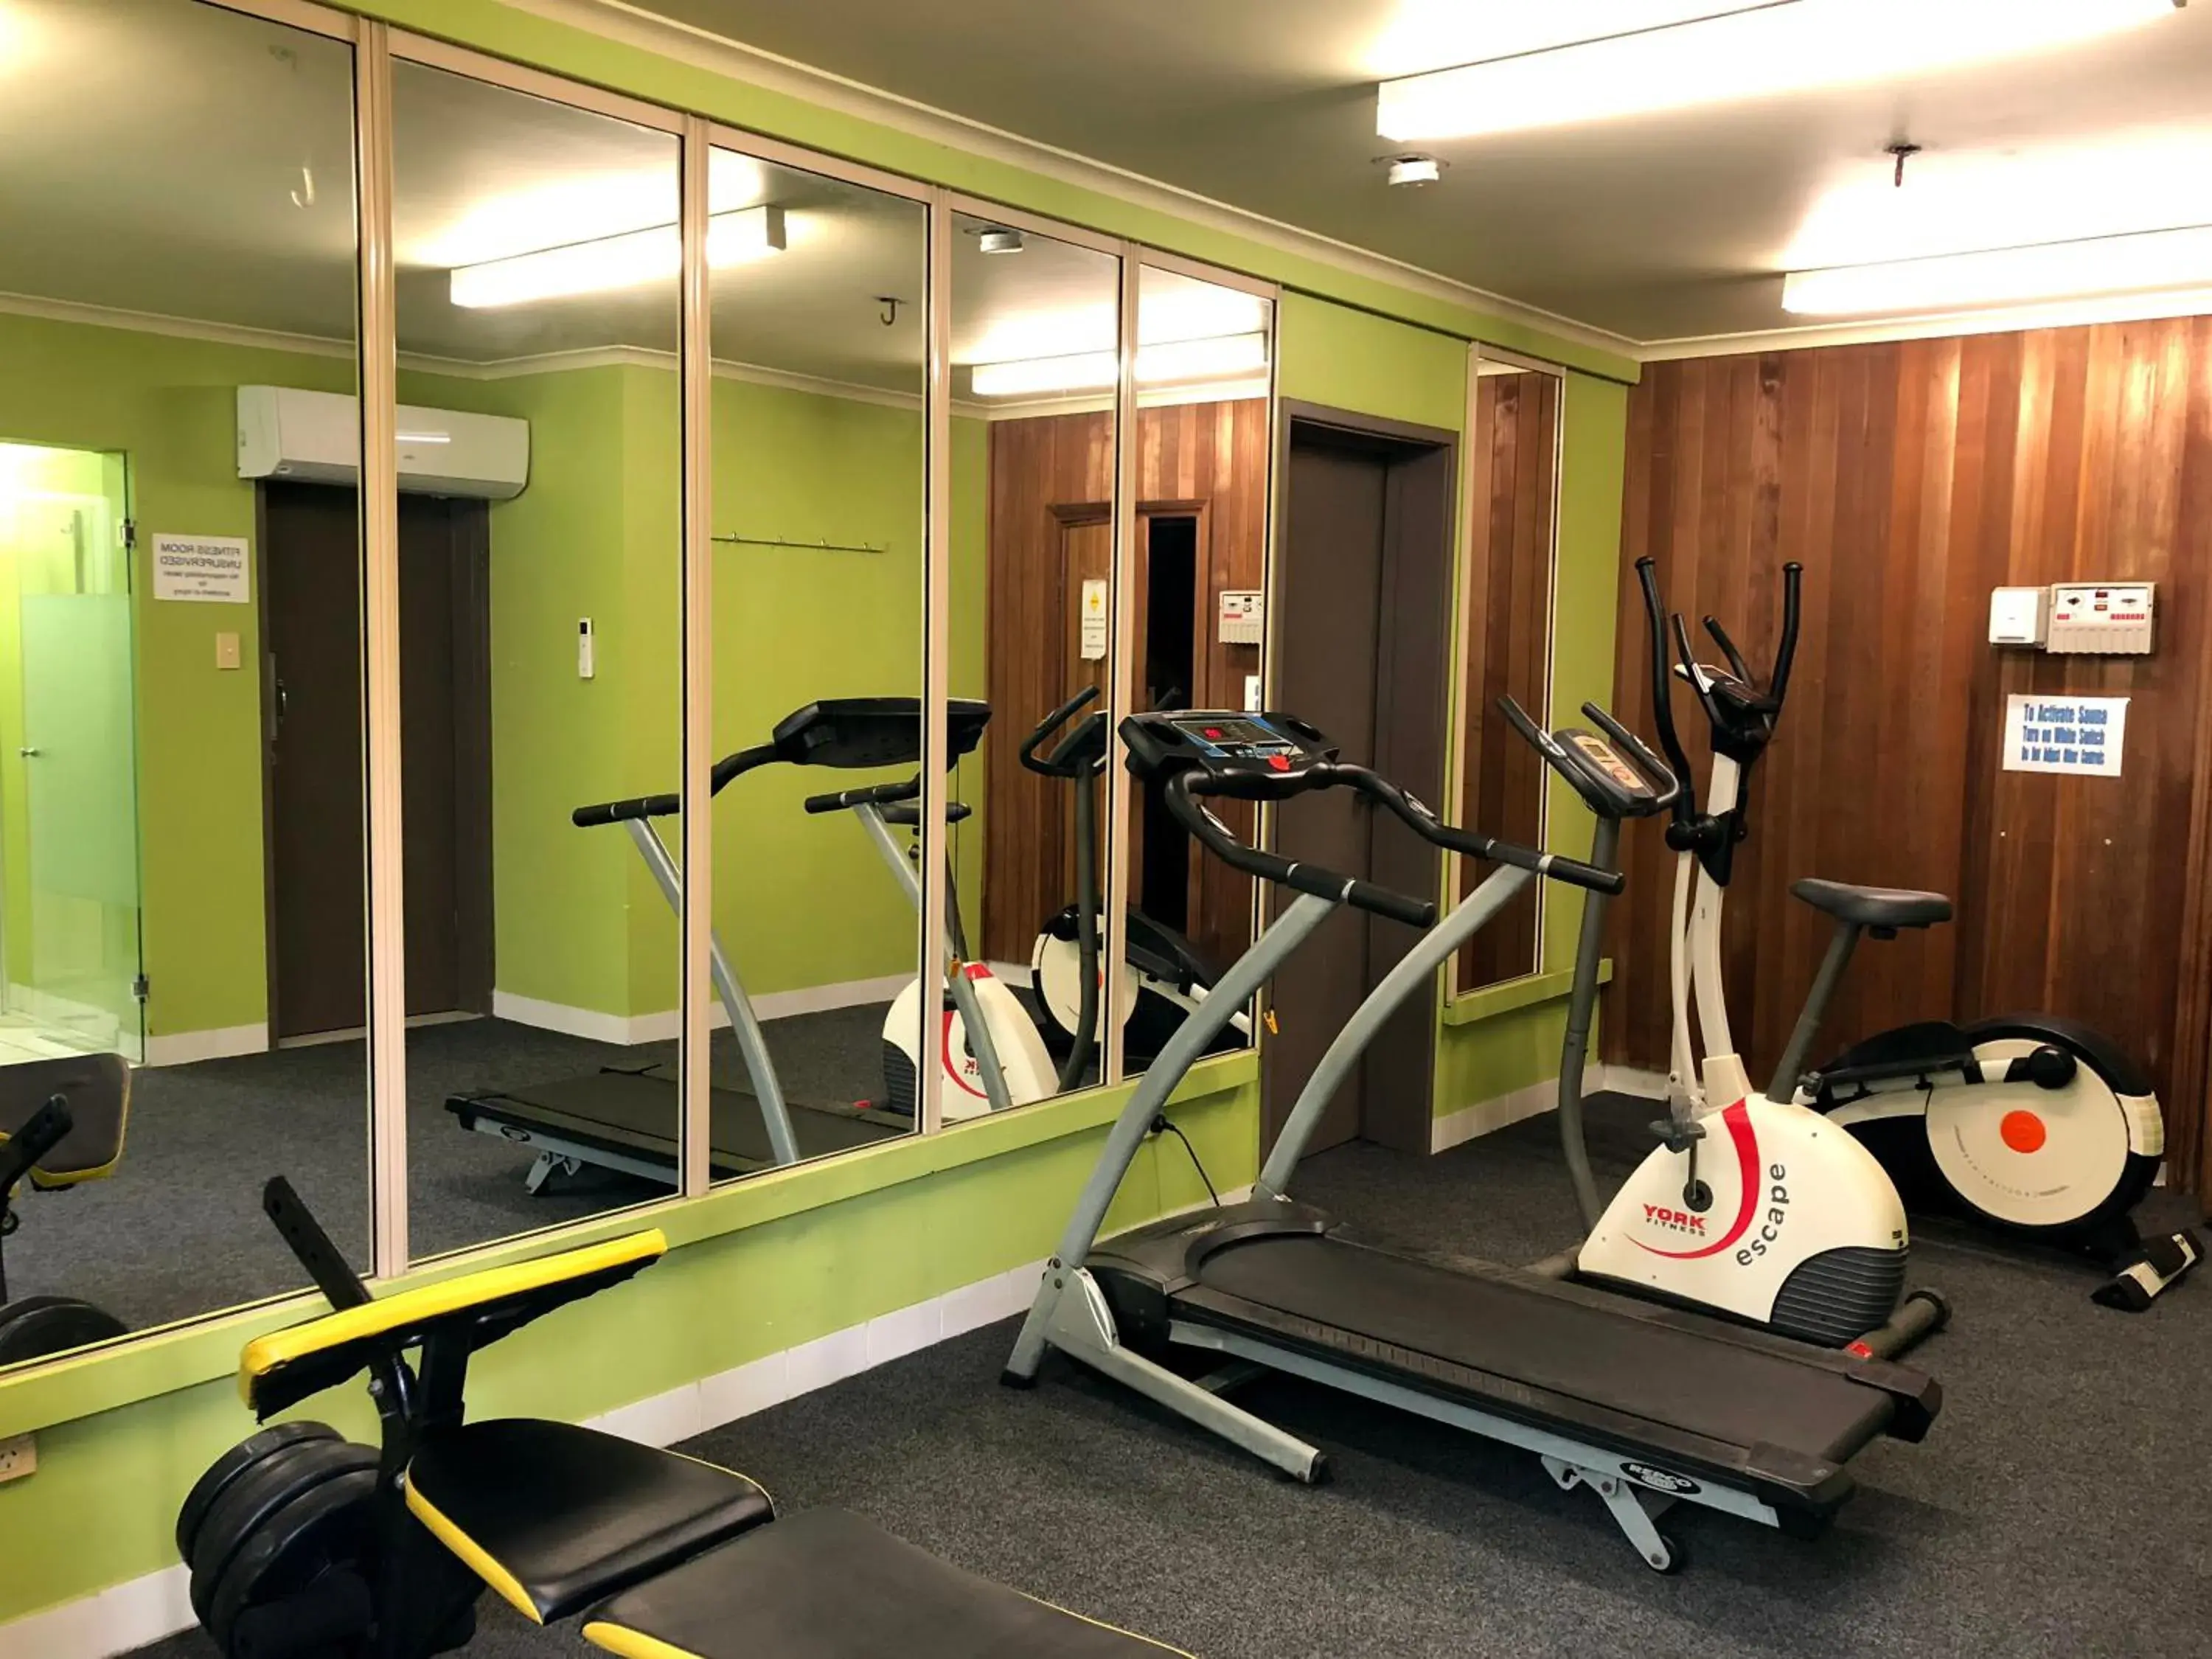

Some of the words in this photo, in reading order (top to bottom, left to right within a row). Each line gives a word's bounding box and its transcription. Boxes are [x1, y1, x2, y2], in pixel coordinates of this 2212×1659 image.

[2024, 703, 2034, 722] To
[2038, 704, 2074, 723] Activate
[2079, 706, 2107, 724] Sauna
[1643, 1203, 1707, 1230] YORK
[1646, 1217, 1706, 1237] FITNESS
[1736, 1164, 1790, 1266] escape
